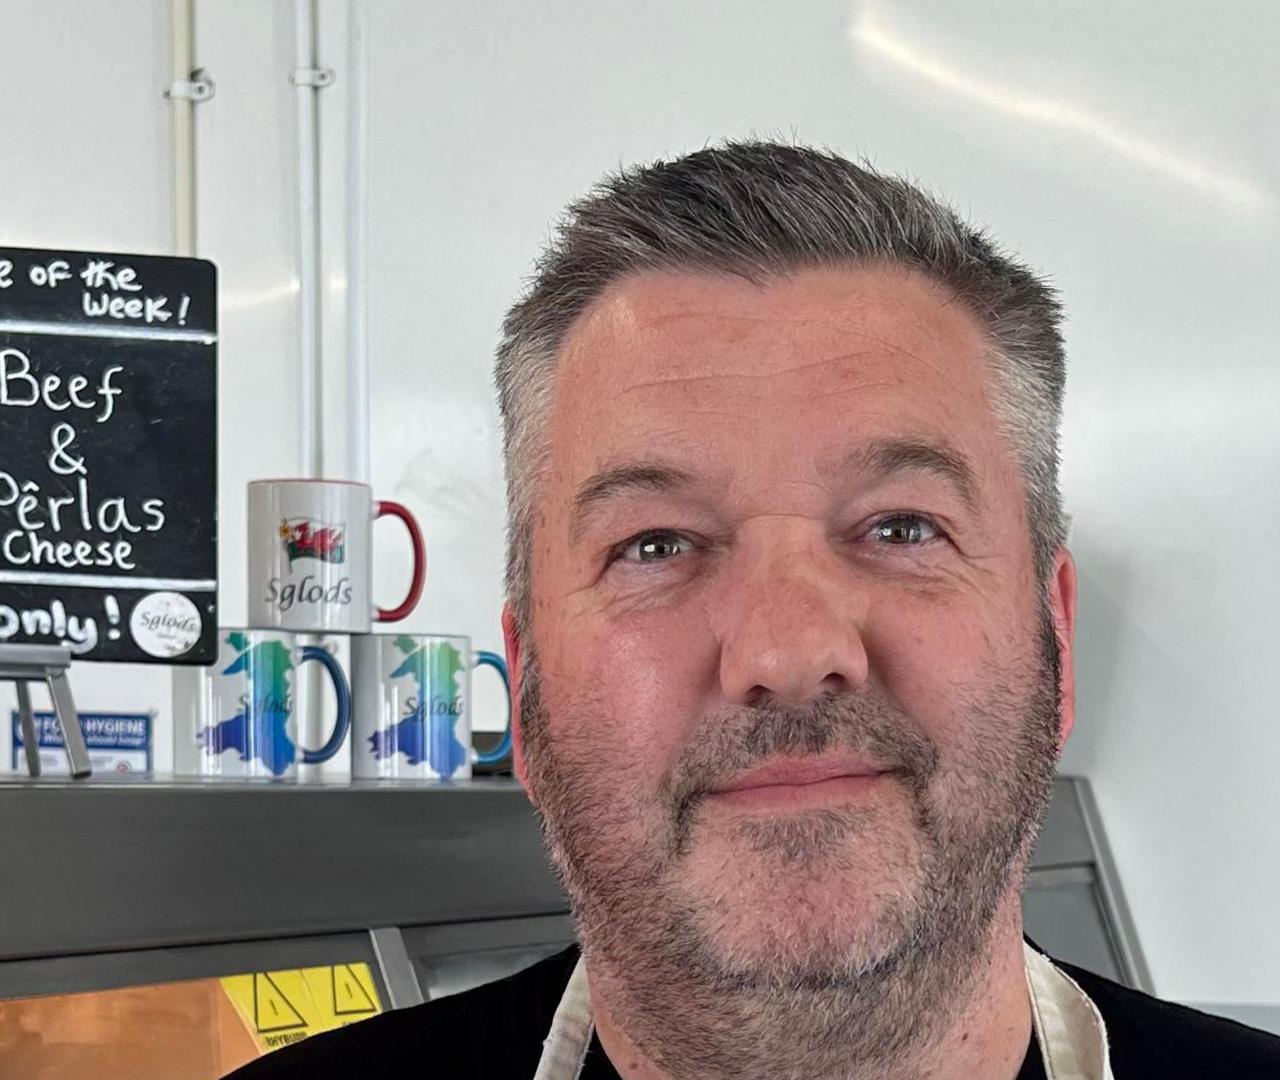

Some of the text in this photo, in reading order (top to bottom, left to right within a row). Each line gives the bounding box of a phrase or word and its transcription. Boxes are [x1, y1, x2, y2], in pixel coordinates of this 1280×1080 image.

[30, 260, 72, 287] of
[80, 258, 142, 291] the
[49, 423, 88, 475] &
[3, 530, 136, 570] Cheese
[264, 576, 354, 612] Sglods
